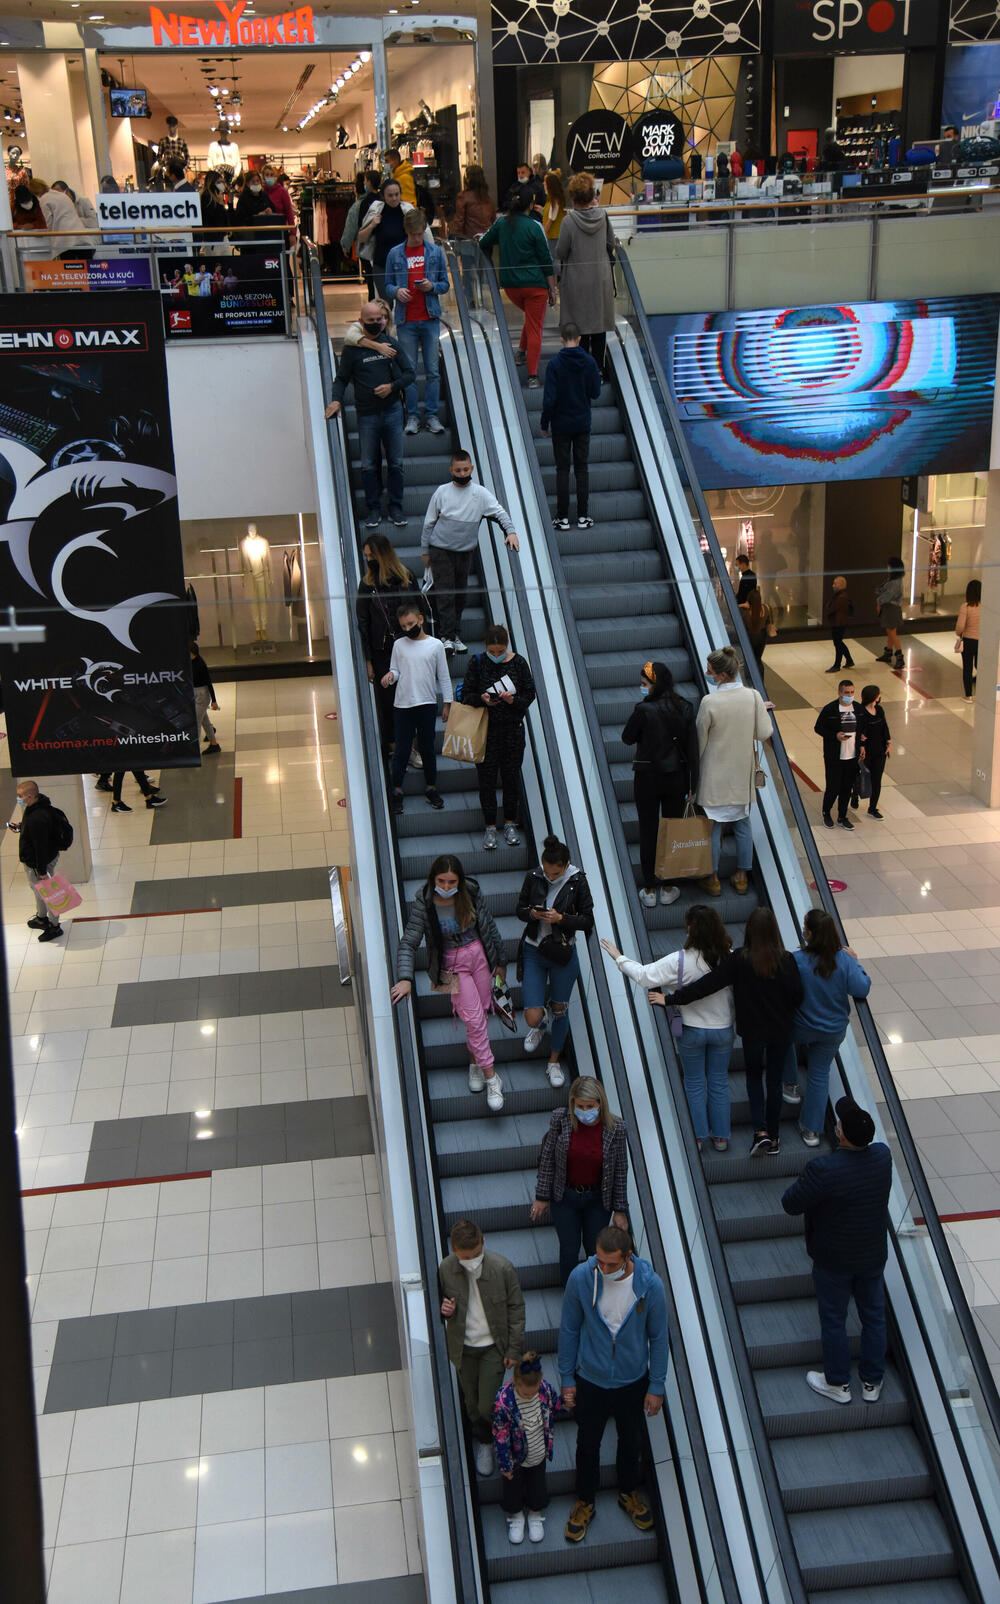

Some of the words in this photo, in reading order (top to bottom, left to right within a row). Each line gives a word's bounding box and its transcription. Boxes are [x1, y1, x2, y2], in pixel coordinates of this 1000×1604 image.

[642, 123, 675, 137] MARK
[569, 120, 627, 166] NEW
[643, 135, 675, 147] YOUR
[588, 151, 620, 159] collection
[642, 146, 671, 157] OWN
[99, 200, 198, 219] telemach
[60, 272, 108, 280] TELEVIZORA
[220, 299, 277, 308] BUNDESLIGE
[14, 677, 72, 692] WHITE
[123, 670, 184, 685] SHARK
[22, 731, 191, 751] tehnomax.me/whiteshark
